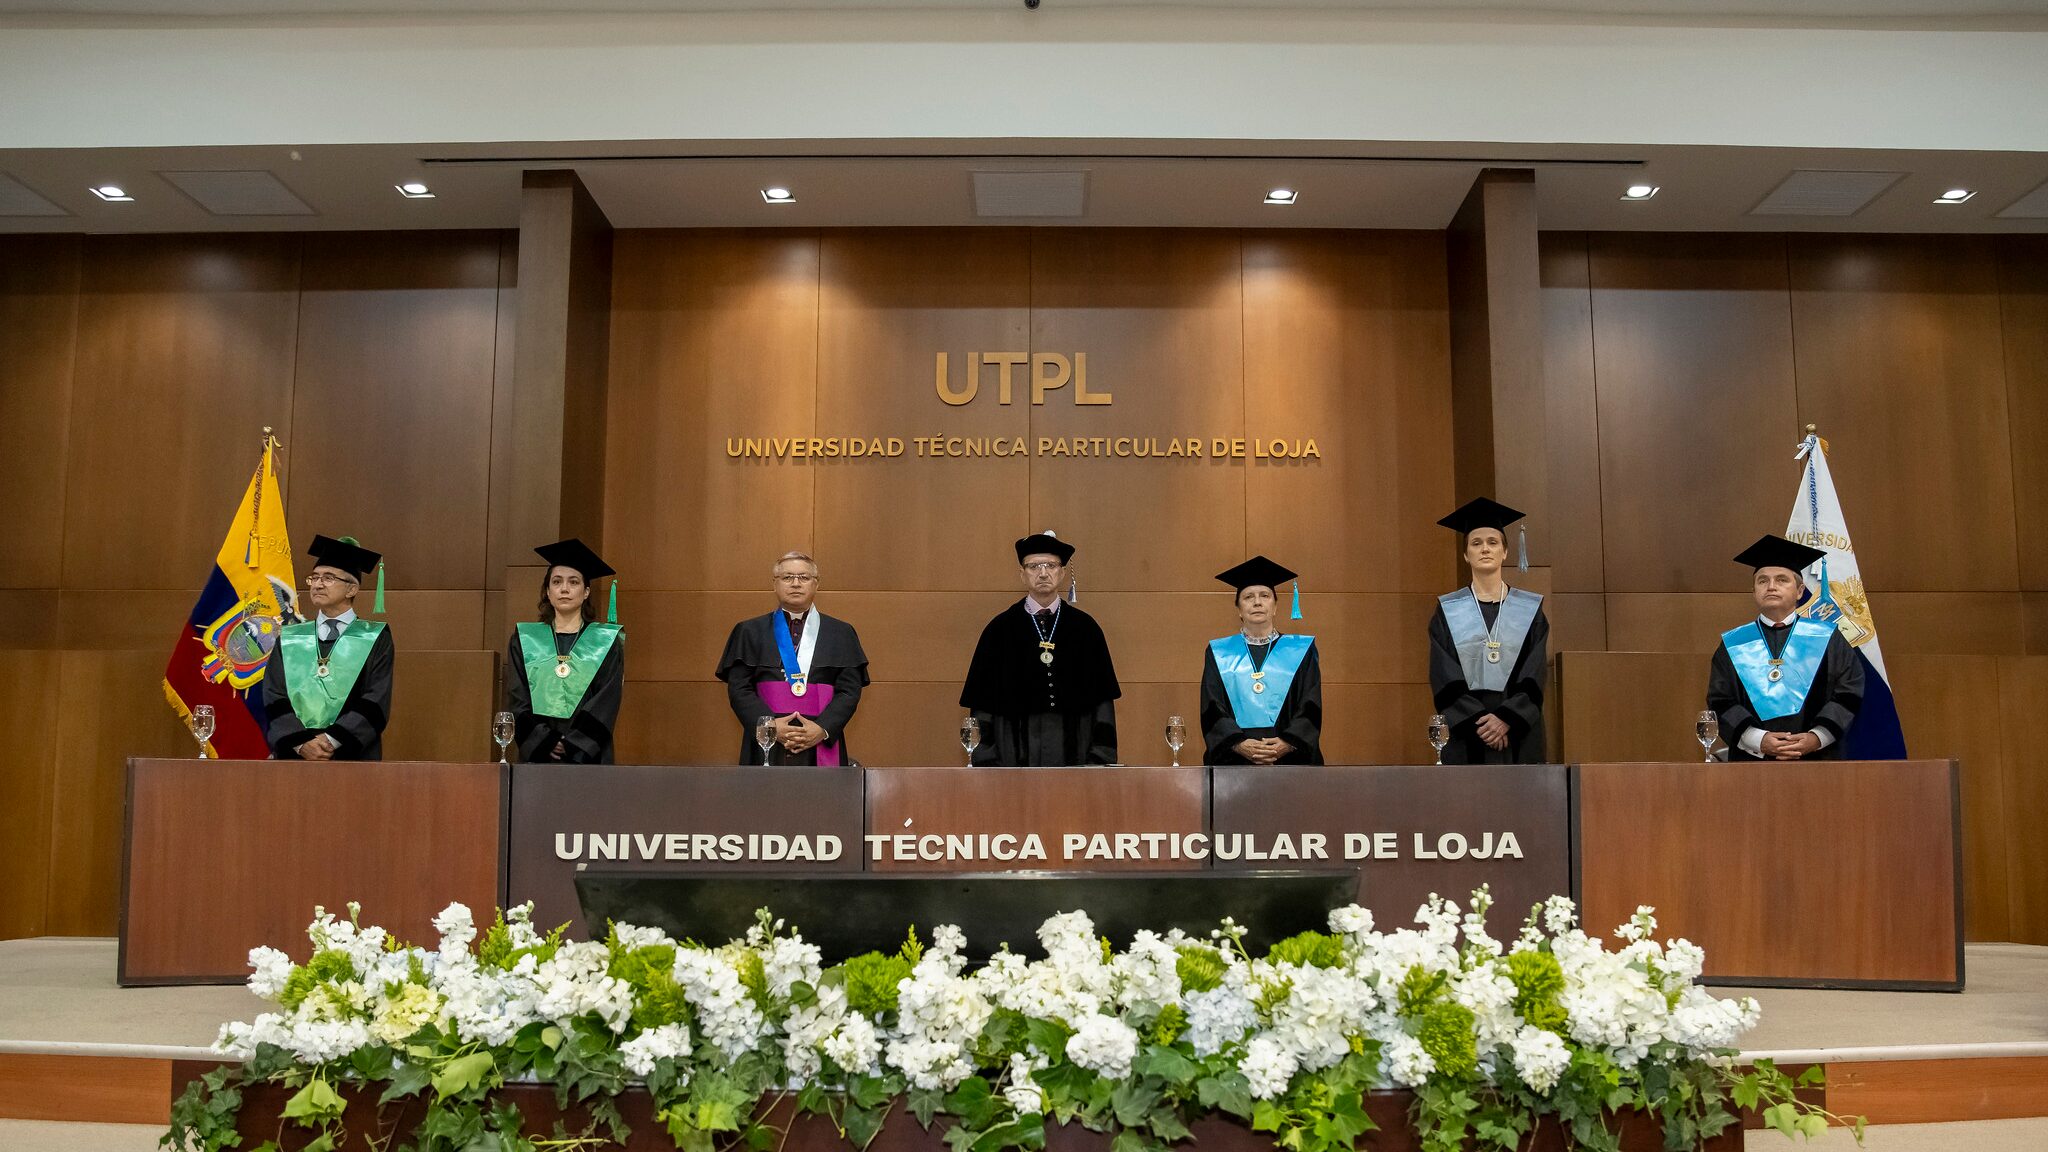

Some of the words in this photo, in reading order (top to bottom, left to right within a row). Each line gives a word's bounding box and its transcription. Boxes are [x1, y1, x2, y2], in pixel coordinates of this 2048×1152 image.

[935, 352, 1112, 405] UTPL
[726, 438, 904, 457] UNIVERSIDAD
[914, 433, 1029, 456] TÉCNICA
[1038, 437, 1202, 457] PARTICULAR
[1210, 439, 1246, 457] DE
[1255, 439, 1321, 458] LOJA
[555, 833, 843, 861] UNIVERSIDAD
[865, 818, 1047, 861] TÉCNICA
[1063, 833, 1329, 860] PARTICULAR
[1344, 833, 1398, 860] DE
[1414, 832, 1524, 860] LOJA
